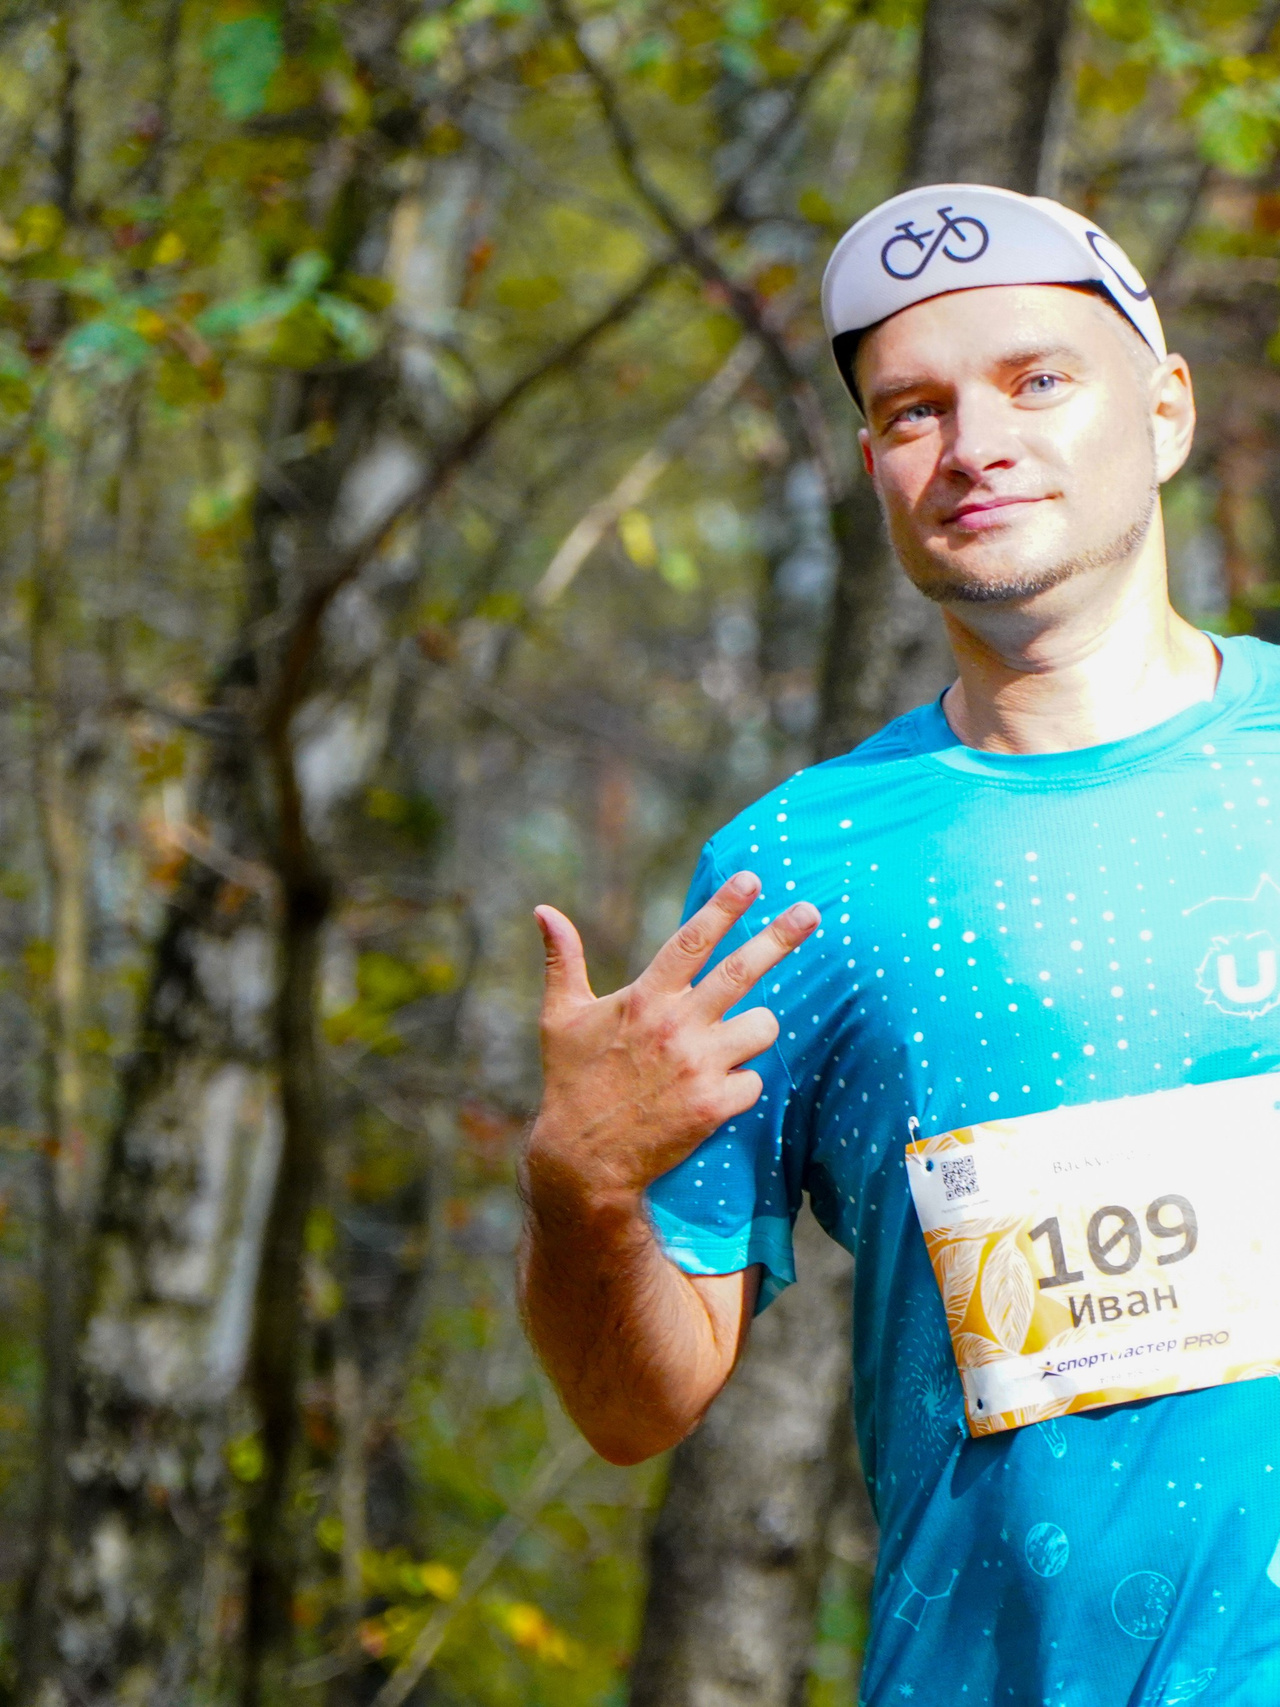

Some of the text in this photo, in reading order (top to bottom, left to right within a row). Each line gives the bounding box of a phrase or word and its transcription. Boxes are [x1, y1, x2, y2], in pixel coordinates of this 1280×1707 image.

[1217, 950, 1277, 1003] U
[1027, 1194, 1199, 1289] 109
[1068, 1285, 1179, 1328] Иван
[1184, 1330, 1230, 1350] PRO
